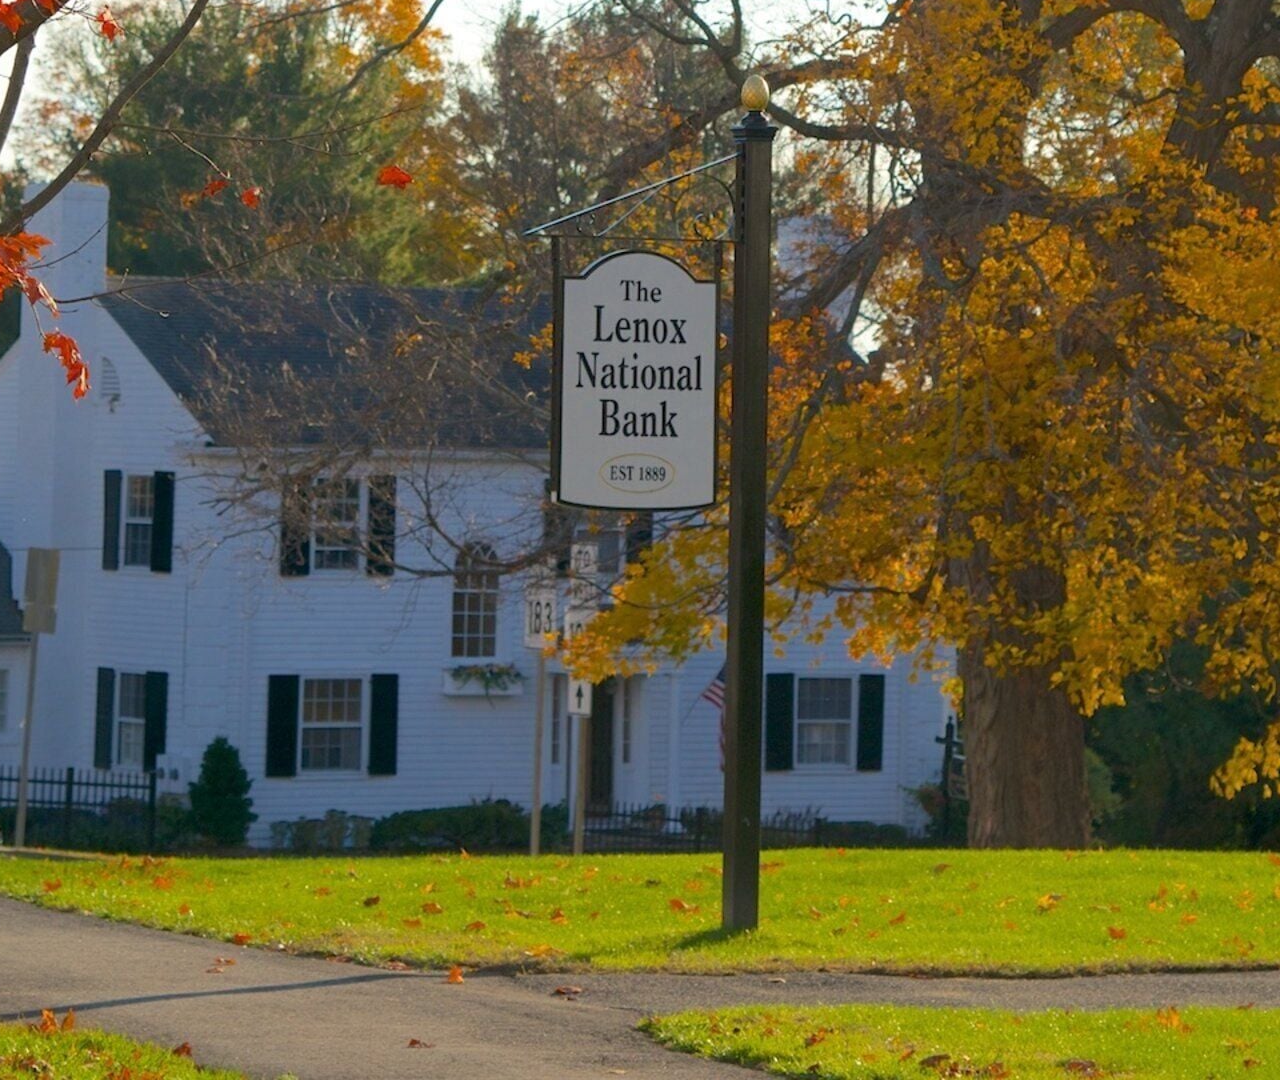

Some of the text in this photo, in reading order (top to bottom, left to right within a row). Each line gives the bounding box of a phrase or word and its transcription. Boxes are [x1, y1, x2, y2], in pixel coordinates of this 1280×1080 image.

[620, 280, 662, 303] The
[593, 305, 687, 344] Lenox
[575, 352, 703, 391] National
[598, 399, 679, 438] Bank
[610, 465, 666, 481] EST 1889
[528, 600, 553, 635] 183
